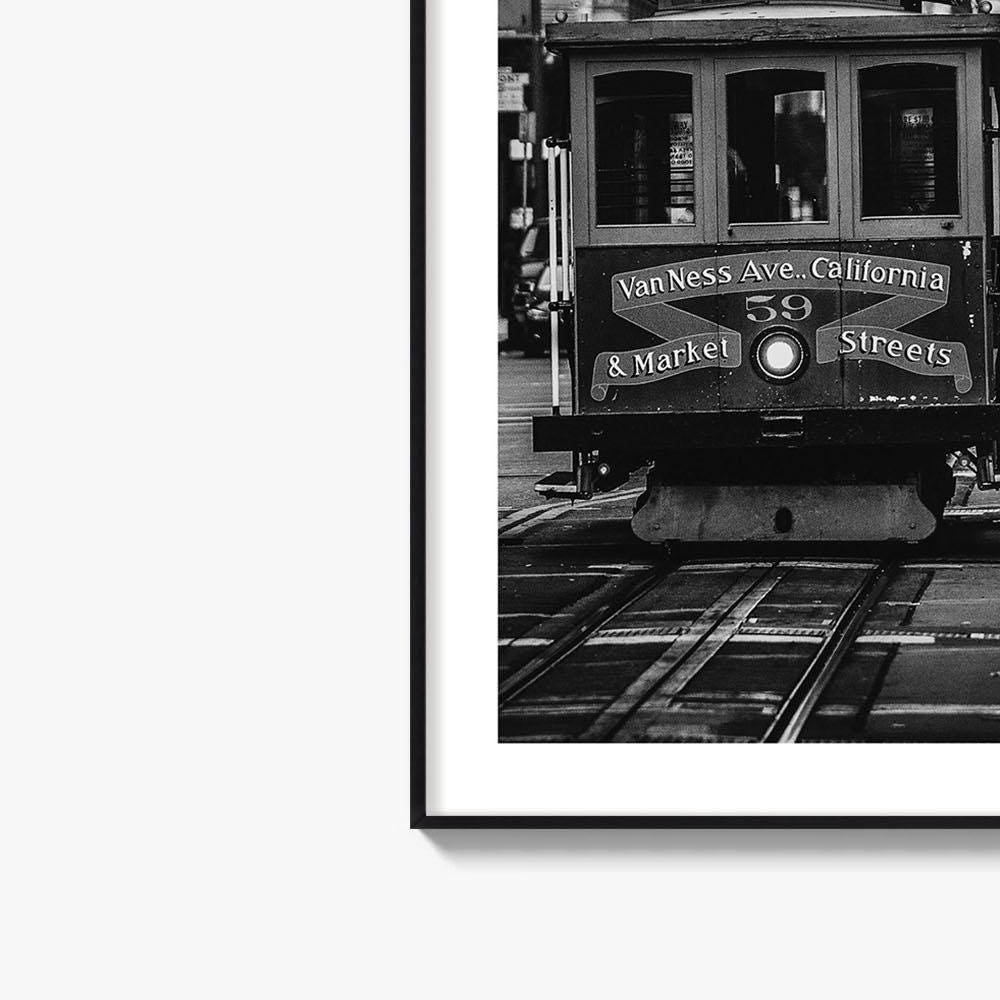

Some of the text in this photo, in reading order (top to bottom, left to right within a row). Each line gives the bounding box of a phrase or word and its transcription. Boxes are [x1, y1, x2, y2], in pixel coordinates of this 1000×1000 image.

[811, 256, 946, 293] California
[745, 294, 812, 323] 59
[608, 330, 952, 378] & Market Streets
